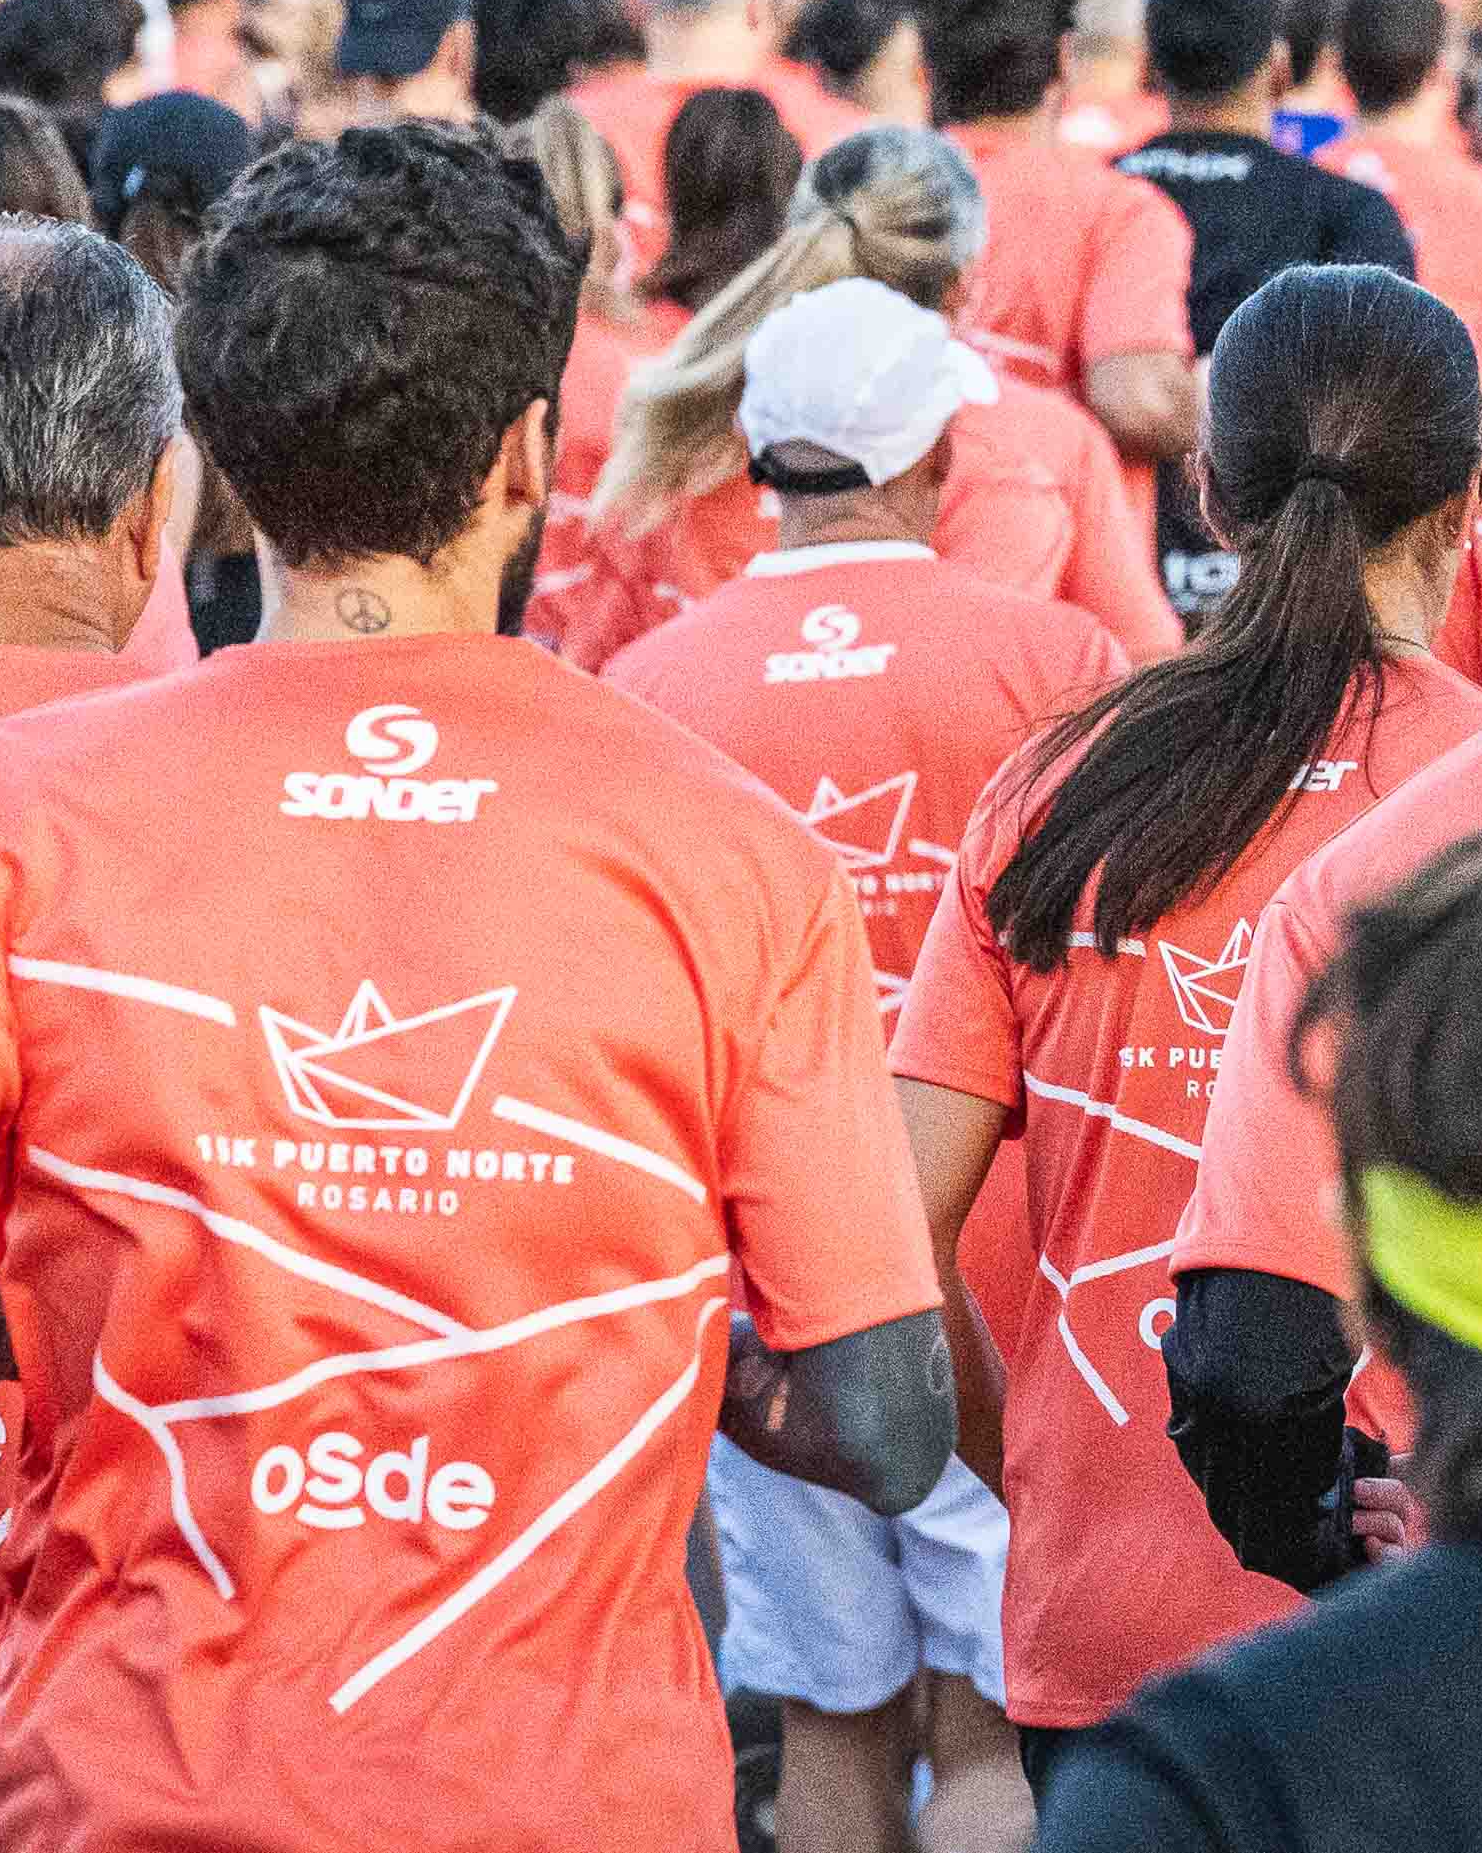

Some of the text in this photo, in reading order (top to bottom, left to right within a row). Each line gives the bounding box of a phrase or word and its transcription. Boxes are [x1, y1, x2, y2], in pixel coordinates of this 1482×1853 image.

[1169, 1046, 1223, 1068] PUE
[272, 1140, 428, 1176] PUERTO
[445, 1149, 576, 1184] NORTE
[296, 1182, 460, 1216] ROSARIO
[251, 1431, 495, 1530] osde
